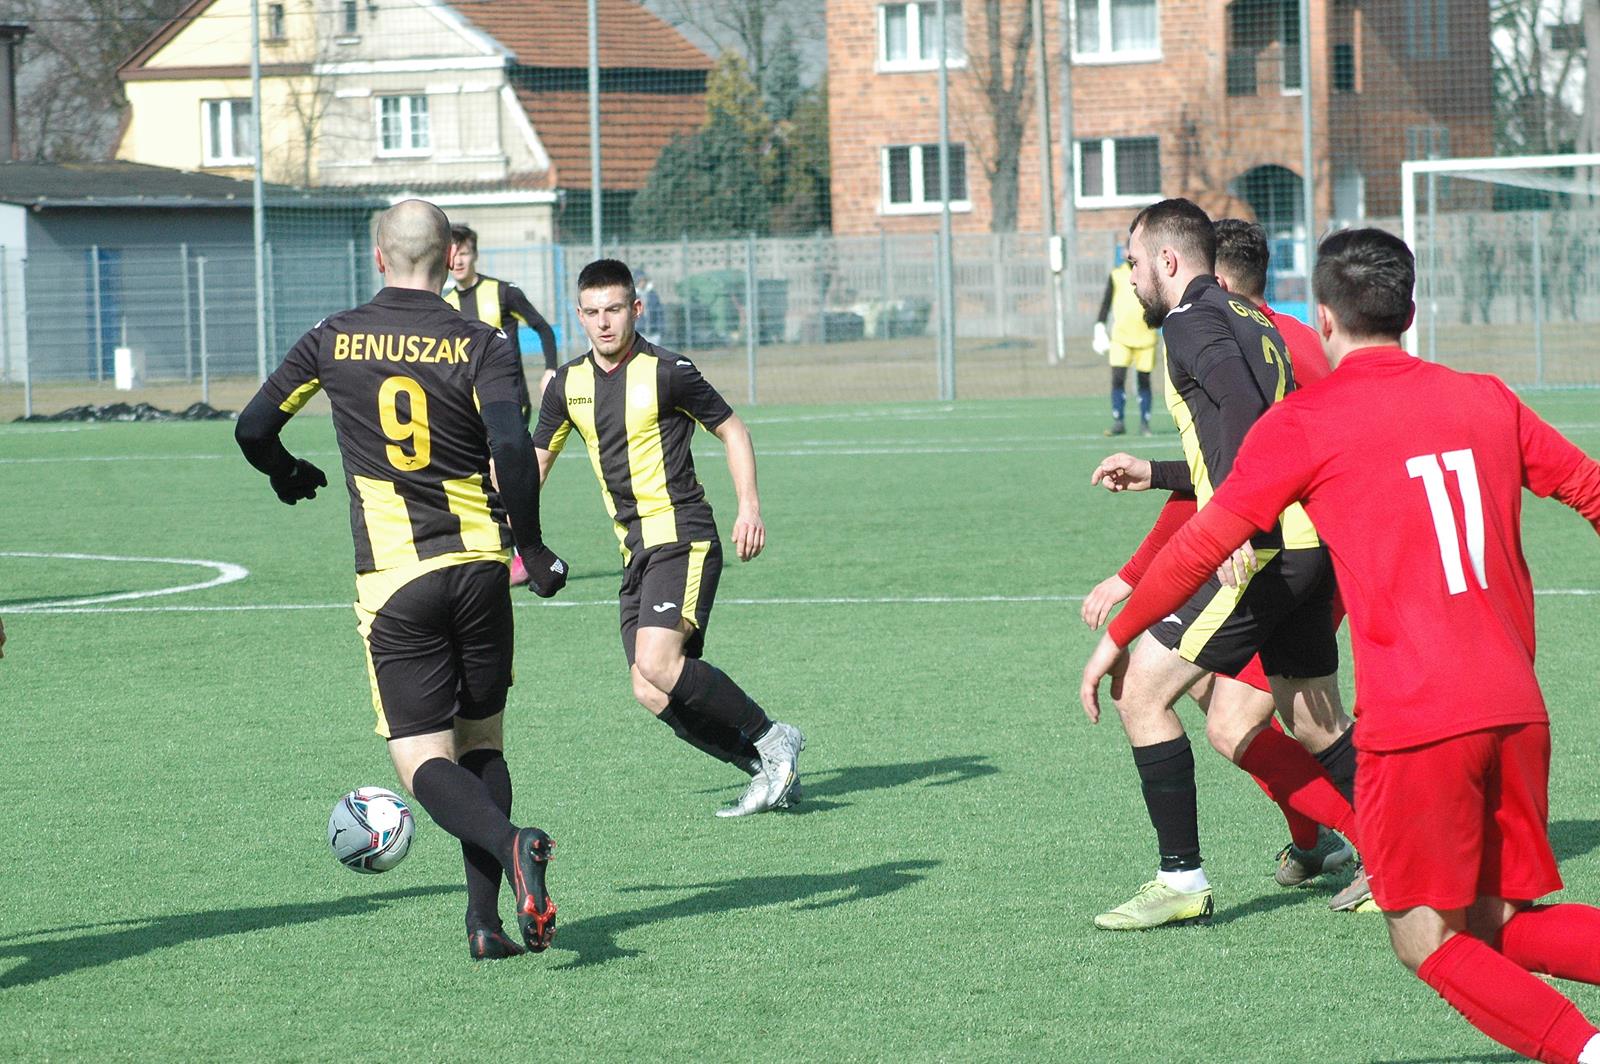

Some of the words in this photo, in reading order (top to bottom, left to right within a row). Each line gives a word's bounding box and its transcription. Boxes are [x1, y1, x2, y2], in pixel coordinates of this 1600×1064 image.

[334, 333, 471, 364] BENUSZAK
[378, 375, 431, 472] 9
[1405, 448, 1489, 596] 11
